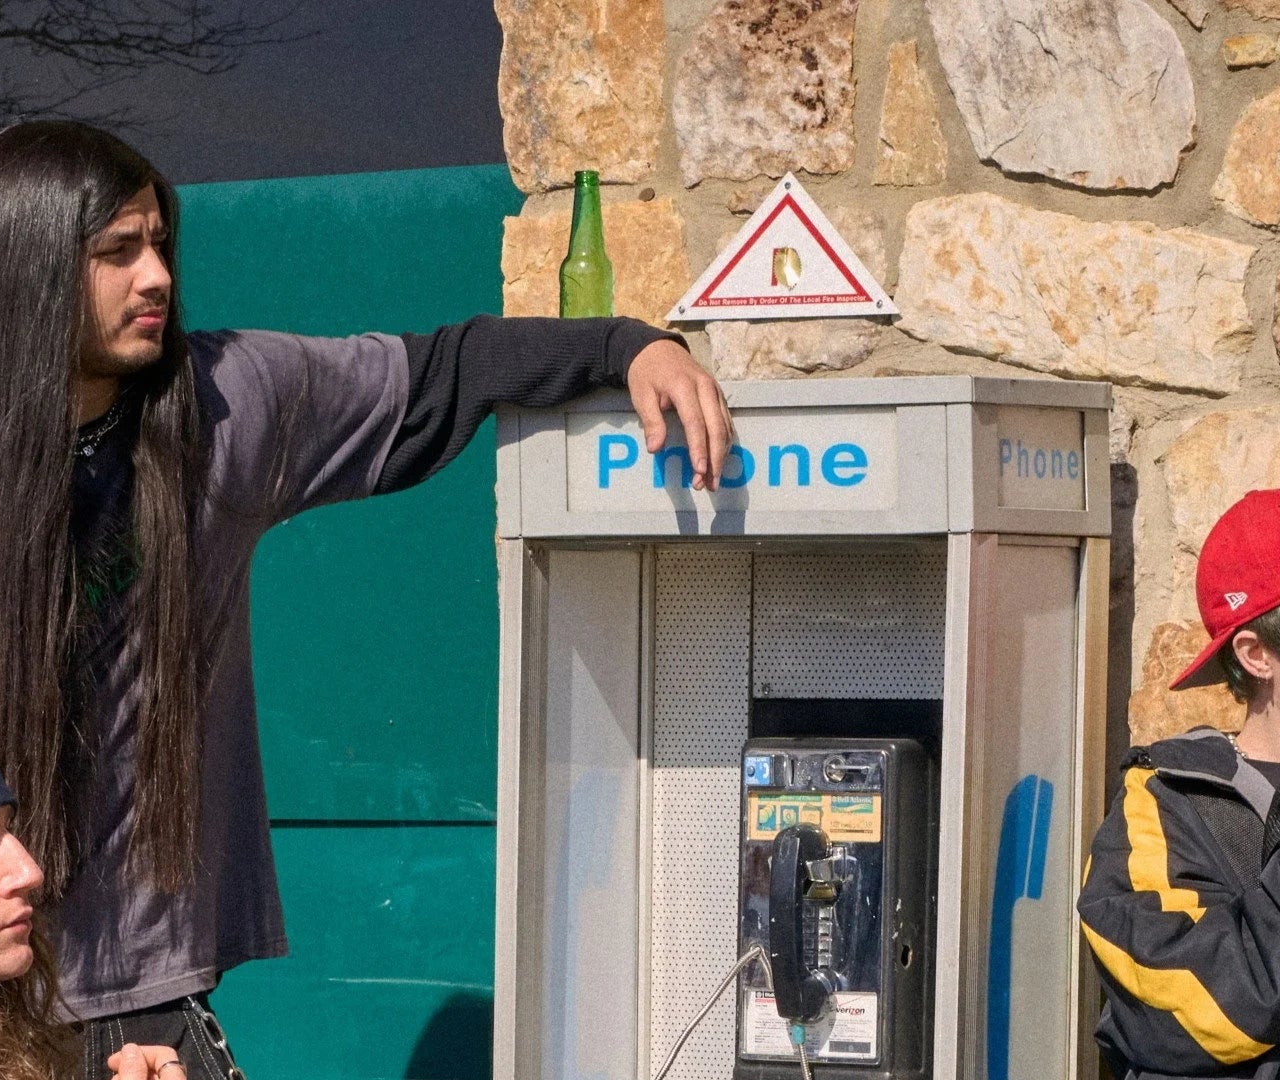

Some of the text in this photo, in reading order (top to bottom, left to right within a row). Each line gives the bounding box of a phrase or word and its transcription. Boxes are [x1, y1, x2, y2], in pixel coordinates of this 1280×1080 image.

[750, 298, 757, 306] By
[837, 295, 866, 303] Inspector
[999, 438, 1079, 480] Phone
[835, 1005, 866, 1016] verizon
